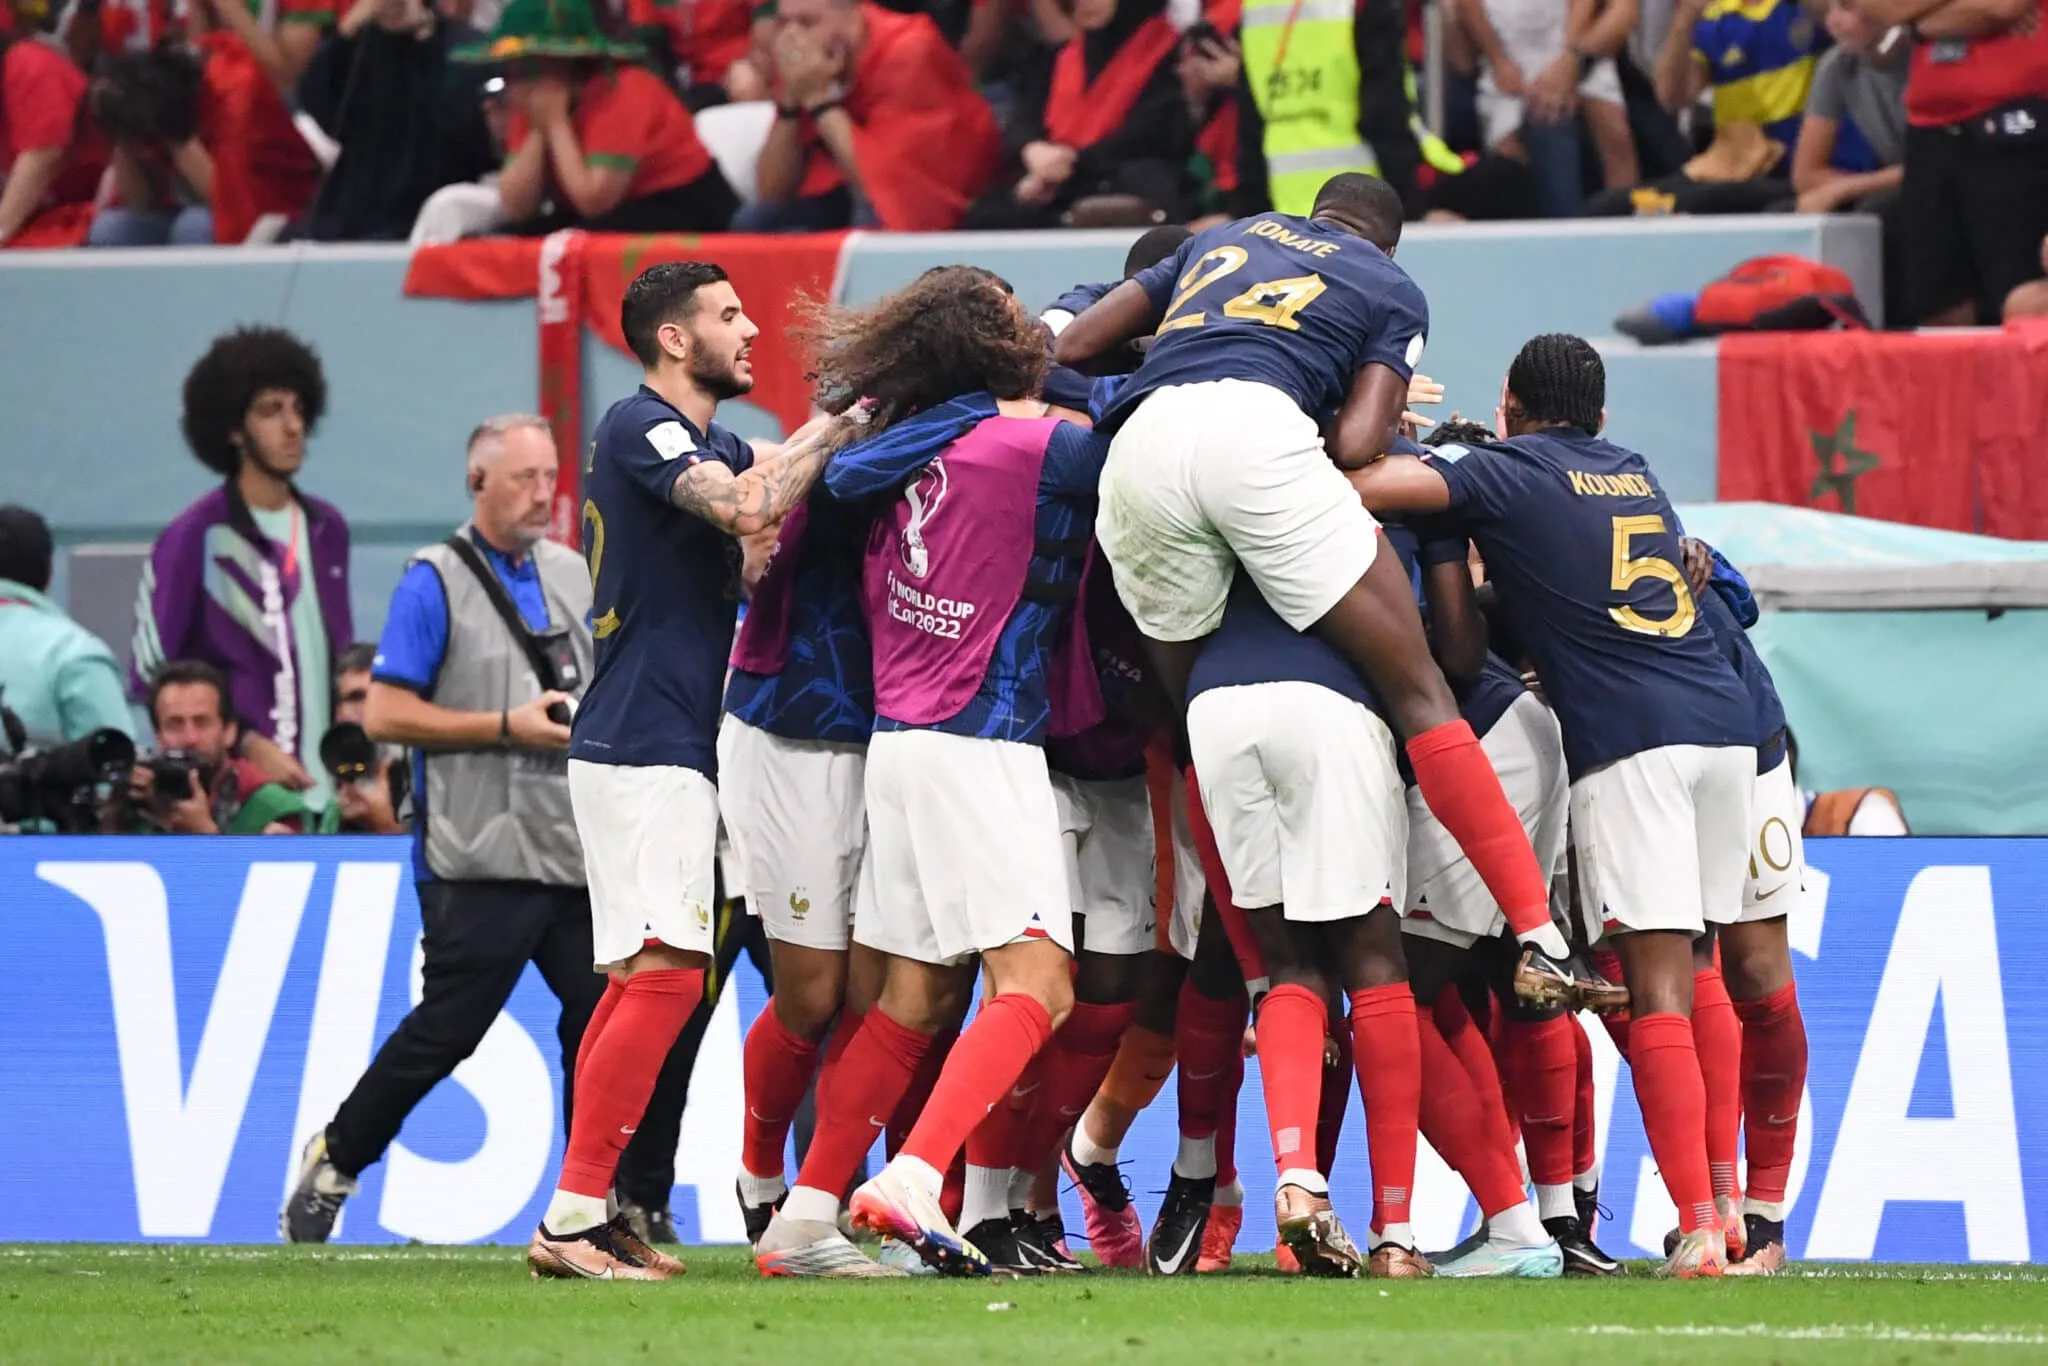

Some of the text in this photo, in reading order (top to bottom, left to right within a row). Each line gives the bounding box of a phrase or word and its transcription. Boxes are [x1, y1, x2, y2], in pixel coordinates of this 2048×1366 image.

[1155, 245, 1328, 337] 24
[896, 580, 935, 611] WORLD
[936, 598, 975, 619] CUP
[1608, 515, 1696, 638] 5
